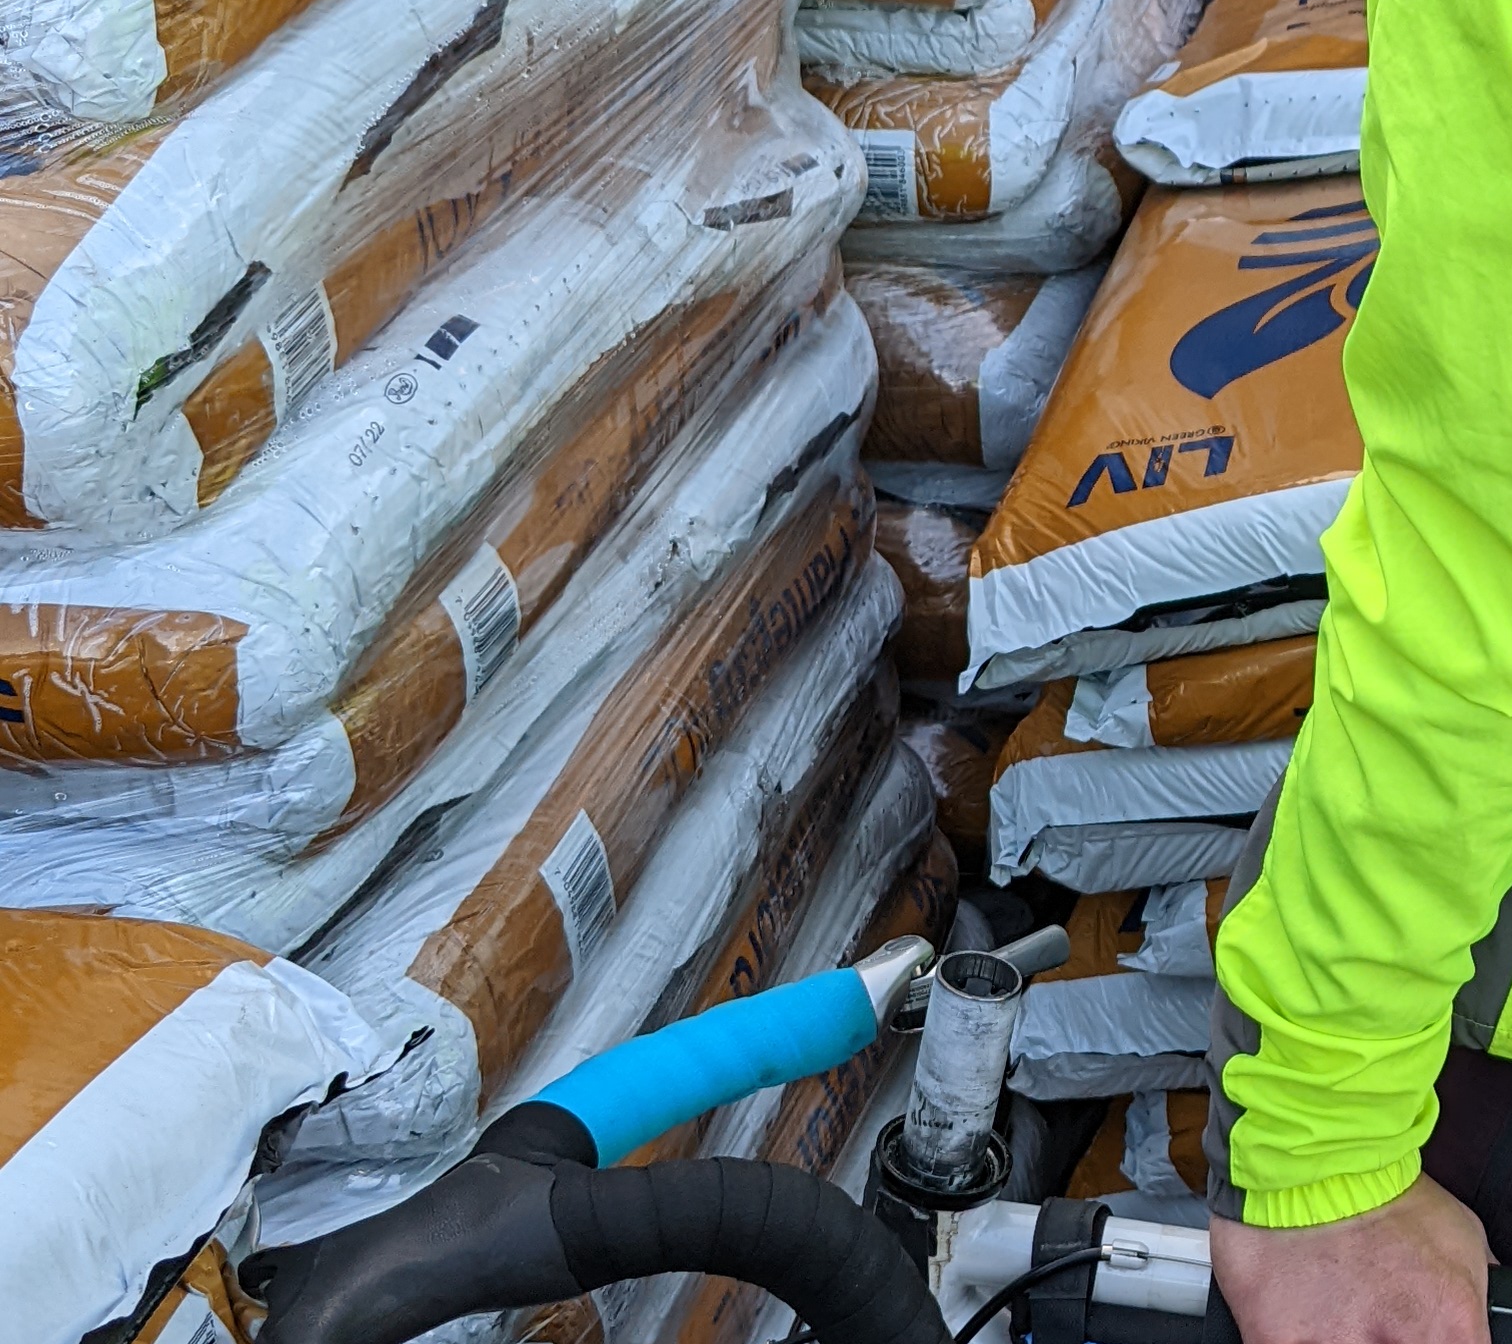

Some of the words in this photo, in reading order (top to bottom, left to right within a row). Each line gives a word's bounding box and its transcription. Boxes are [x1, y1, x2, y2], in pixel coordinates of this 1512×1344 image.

[348, 420, 387, 467] 07/22
[1106, 436, 1155, 450] VIKING
[1161, 427, 1205, 442] GREEN
[1066, 435, 1235, 509] LIV
